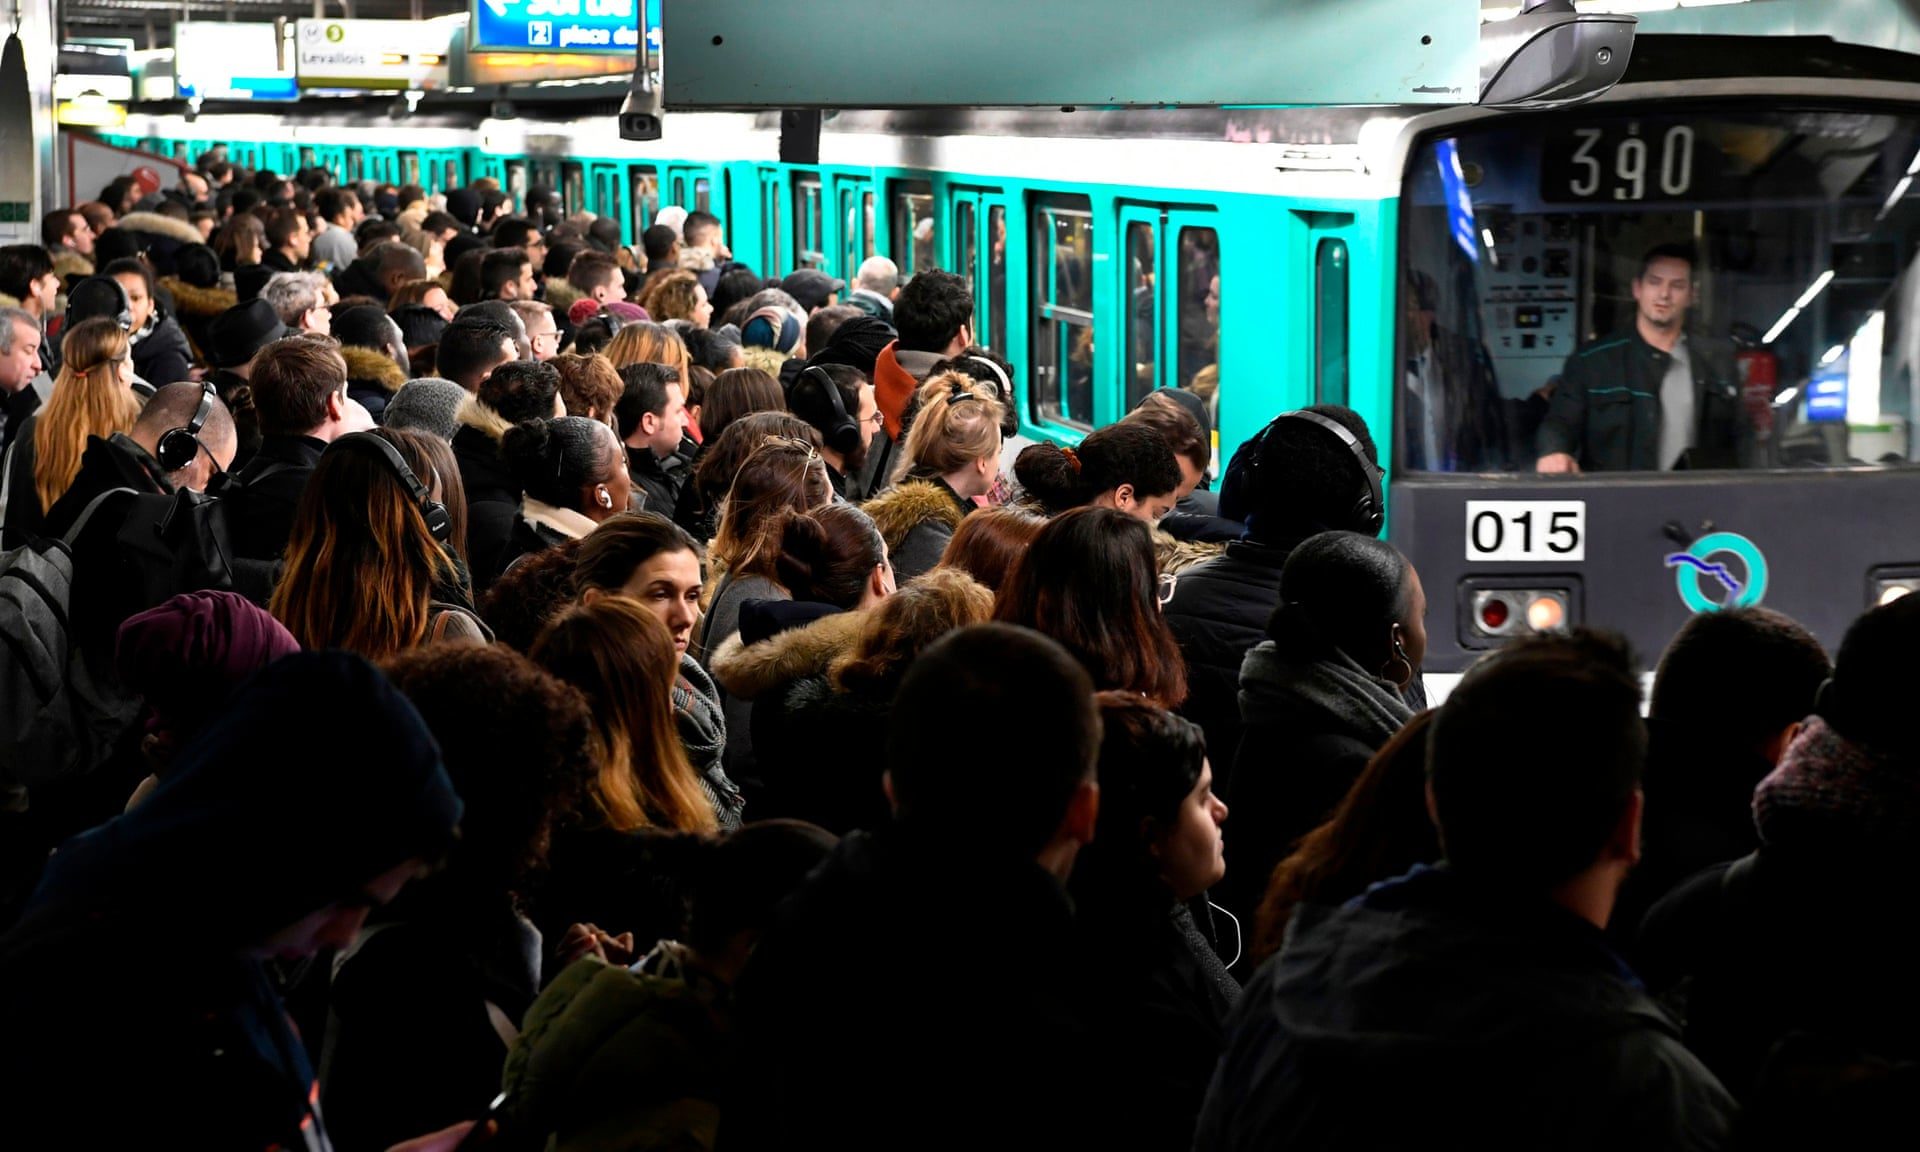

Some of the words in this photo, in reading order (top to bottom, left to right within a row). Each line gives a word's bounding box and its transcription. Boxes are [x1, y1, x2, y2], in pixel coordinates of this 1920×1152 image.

[531, 22, 549, 44] 2
[559, 24, 611, 47] place
[302, 52, 366, 65] Levallois
[1570, 126, 1694, 199] 390
[1472, 510, 1579, 553] 015
